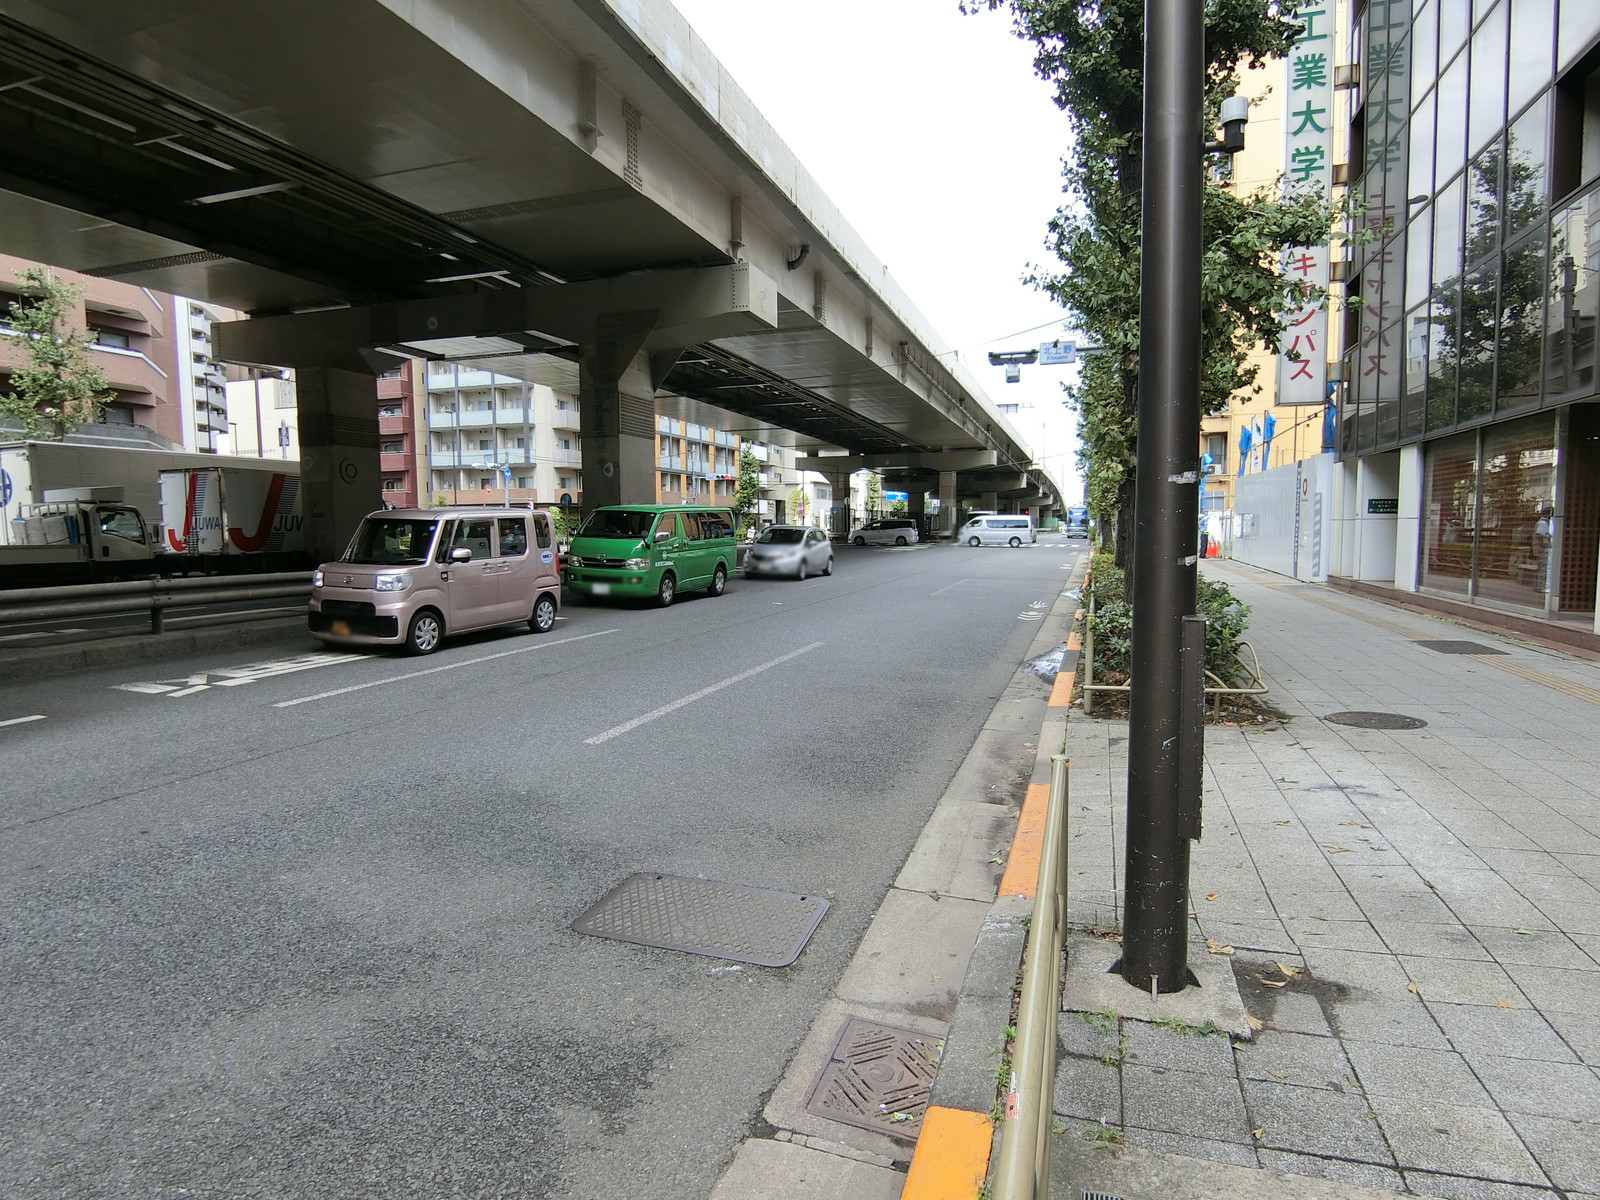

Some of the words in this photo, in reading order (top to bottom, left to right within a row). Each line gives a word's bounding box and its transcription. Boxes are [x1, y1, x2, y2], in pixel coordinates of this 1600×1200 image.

[1290, 9, 1328, 182] 工業大学
[1043, 344, 1072, 355] 北上野
